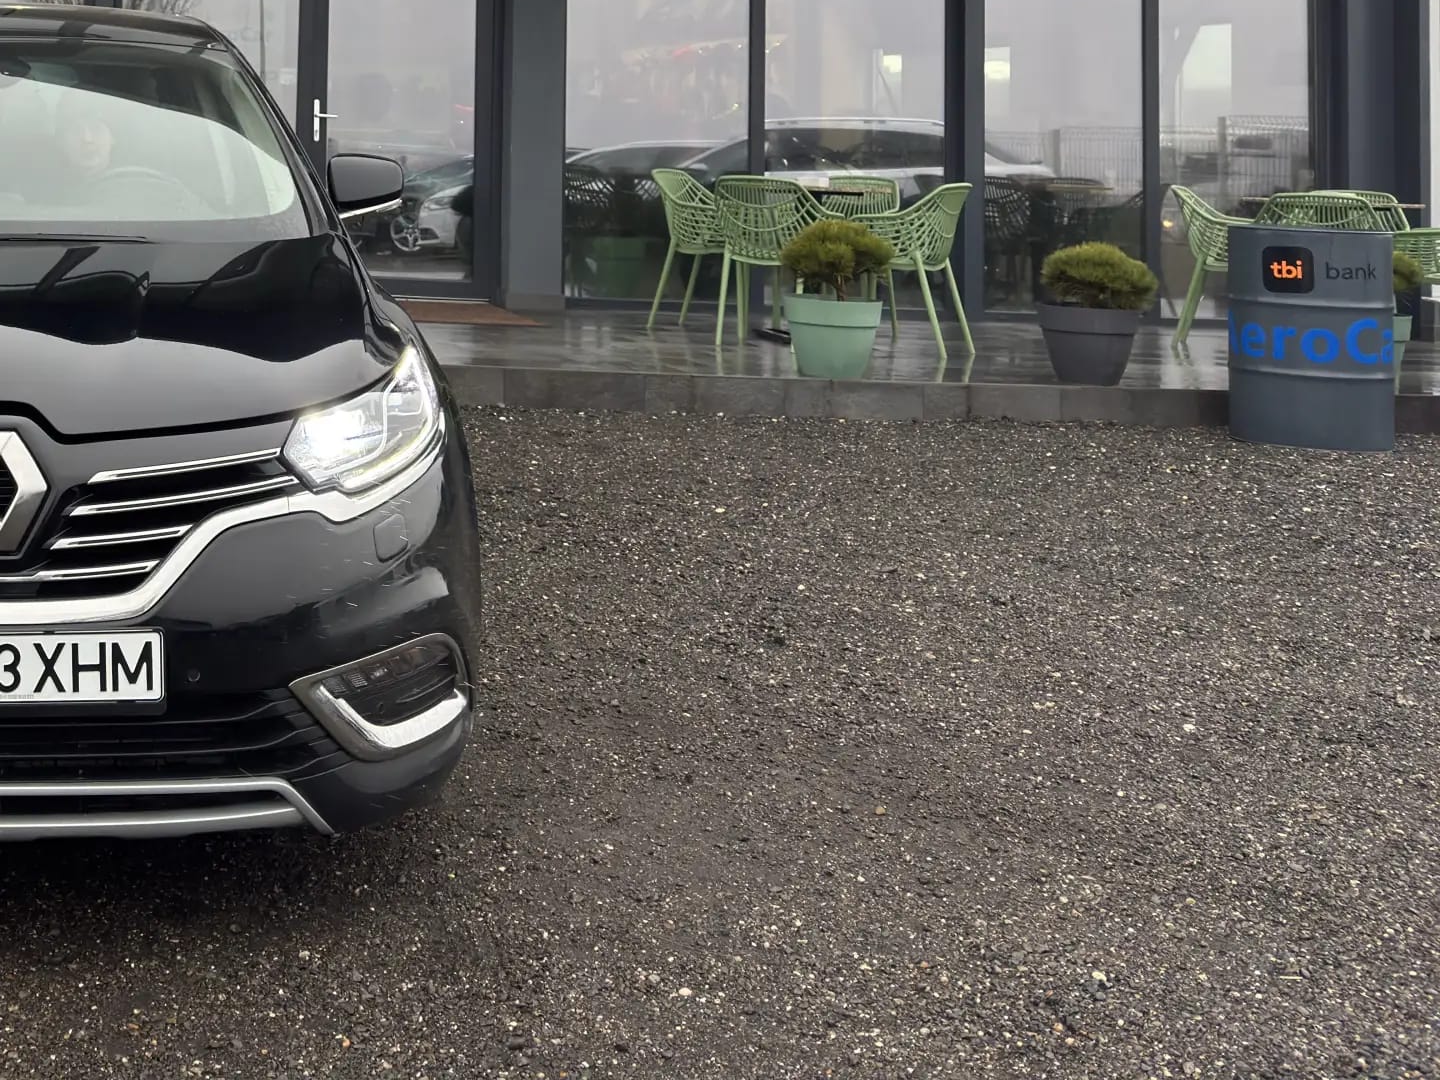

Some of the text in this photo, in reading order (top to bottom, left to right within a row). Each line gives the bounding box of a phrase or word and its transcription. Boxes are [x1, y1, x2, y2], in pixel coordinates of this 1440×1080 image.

[1270, 260, 1377, 280] tbi bank
[33, 641, 154, 694] XHM
